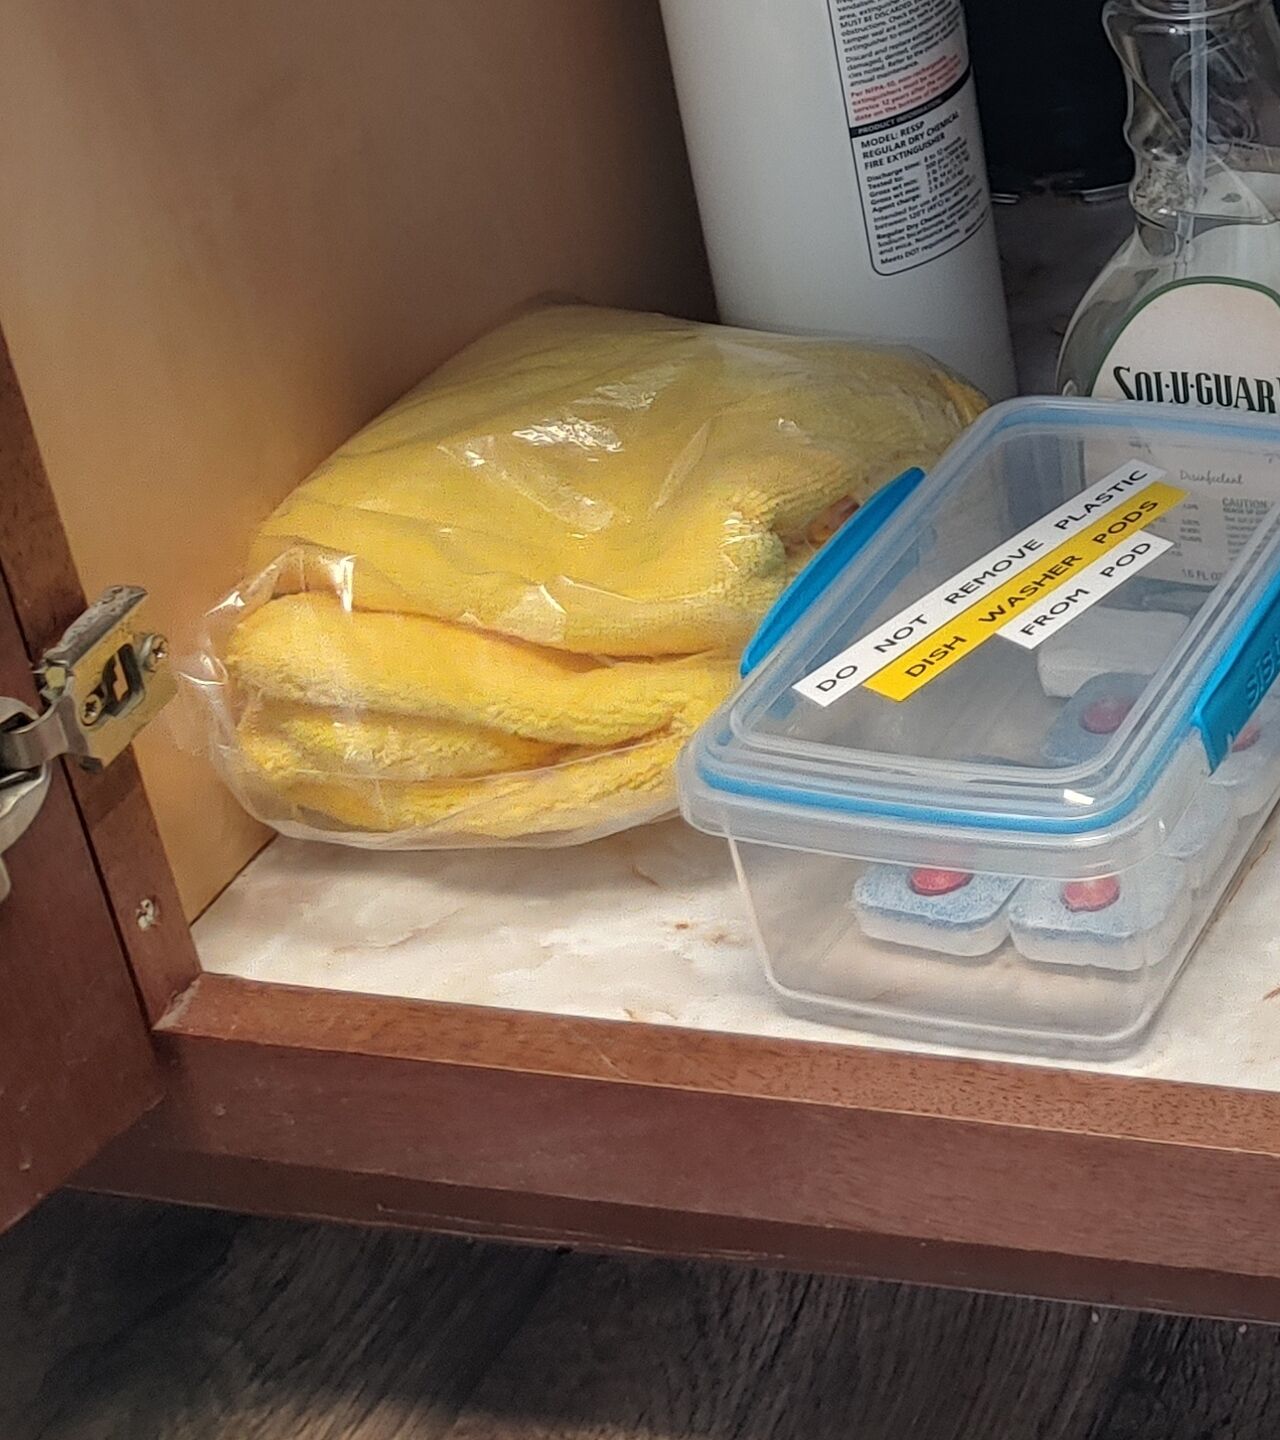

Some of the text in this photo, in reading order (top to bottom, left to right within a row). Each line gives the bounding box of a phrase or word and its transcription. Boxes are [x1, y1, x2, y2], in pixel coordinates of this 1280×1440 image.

[840, 16, 862, 28] MUST
[861, 132, 898, 148] MODEL:
[862, 139, 907, 159] REGULAR
[908, 132, 925, 145] DRY
[864, 131, 945, 170] FIRE EXTINGUISHER
[816, 664, 858, 692] DO
[874, 614, 928, 653] NOT
[944, 539, 1044, 604] REMOVE
[1054, 468, 1149, 530] PLASTIC
[905, 636, 967, 677] DISH
[978, 555, 1083, 624] WASHER
[1093, 499, 1160, 545] PODS
[1020, 541, 1151, 636] FROM POD
